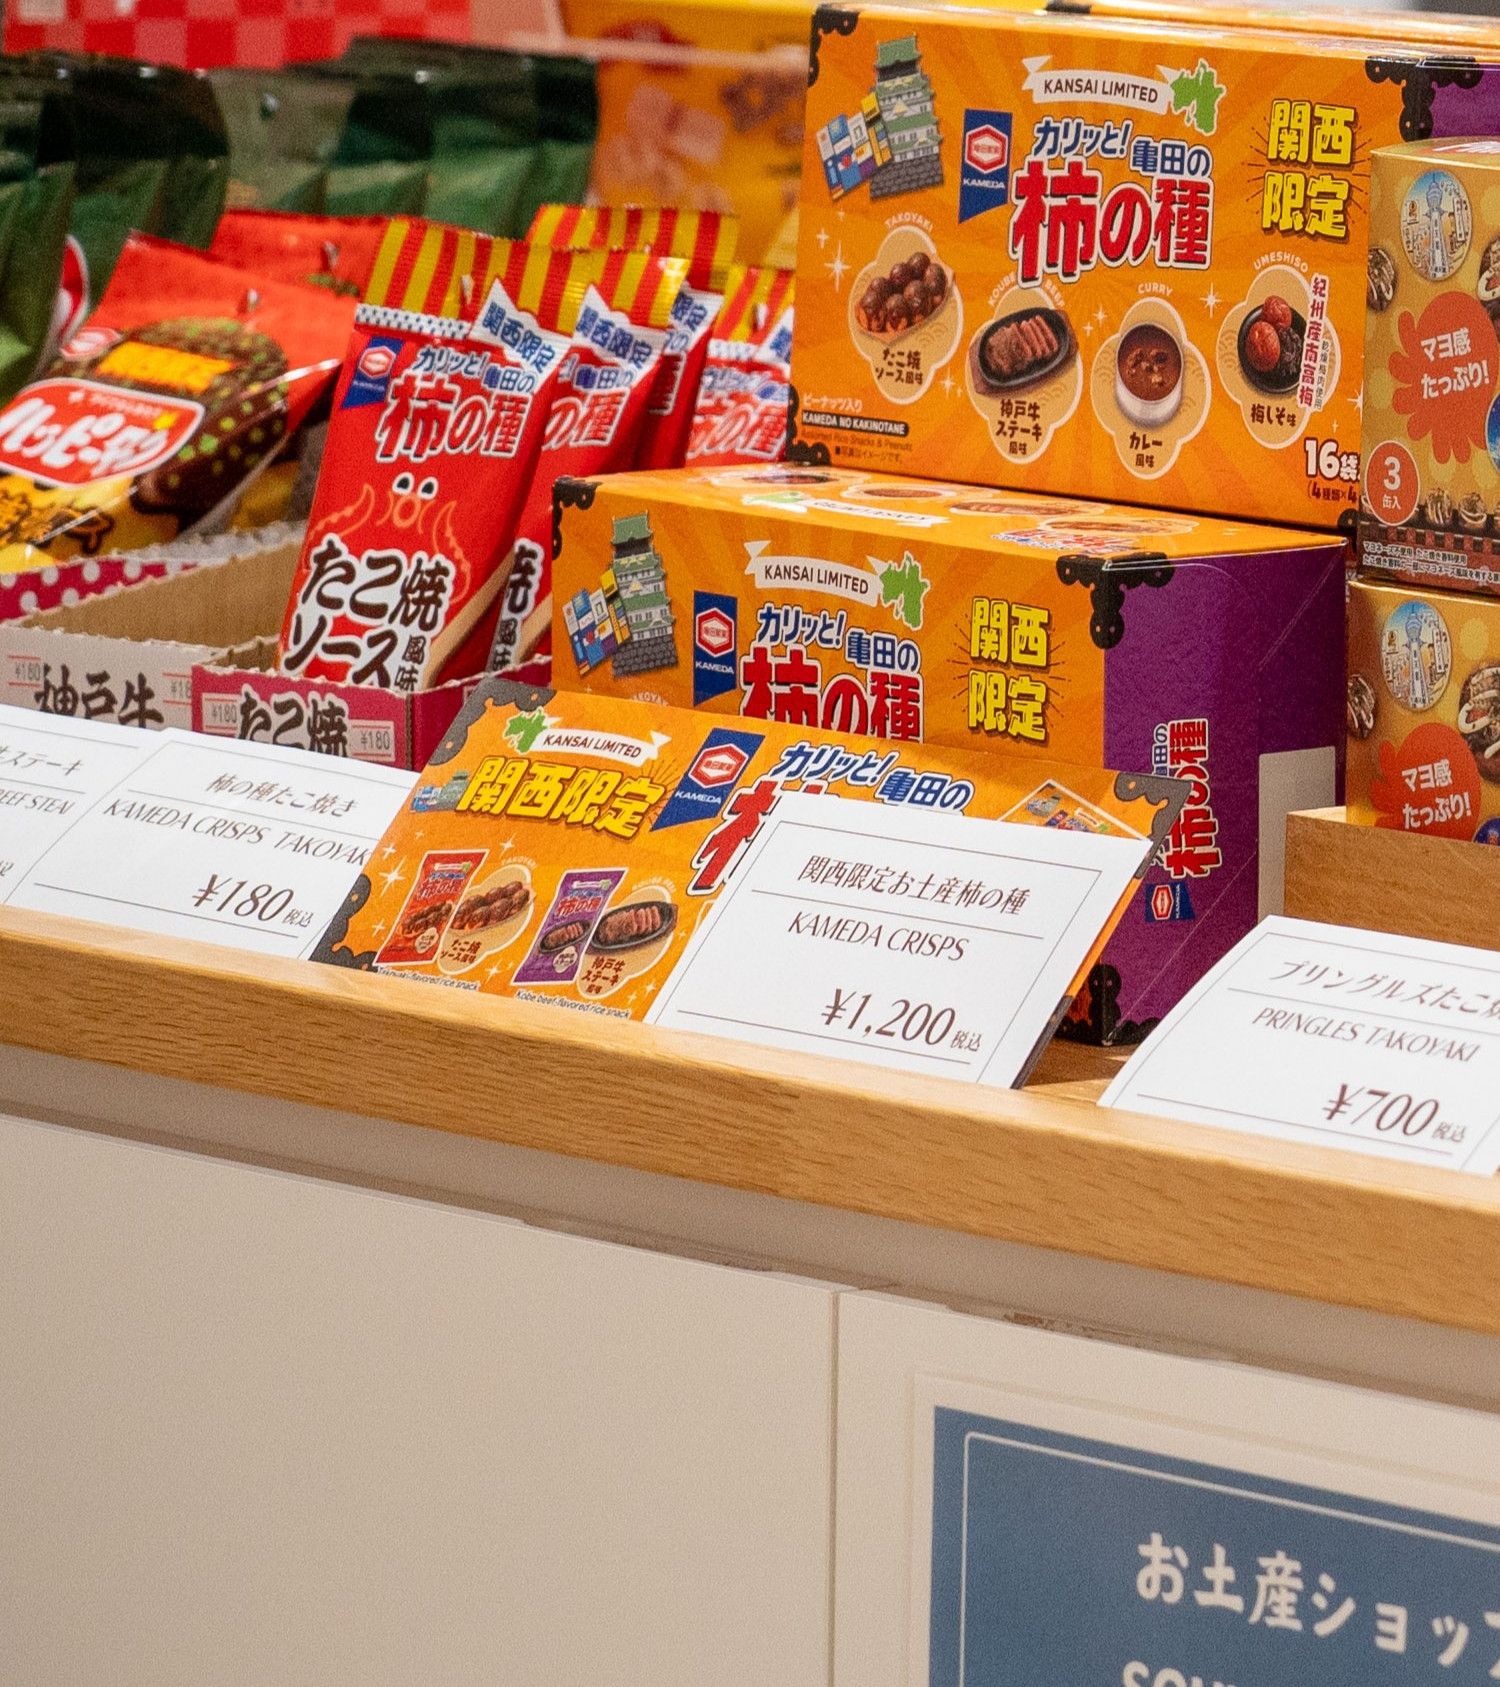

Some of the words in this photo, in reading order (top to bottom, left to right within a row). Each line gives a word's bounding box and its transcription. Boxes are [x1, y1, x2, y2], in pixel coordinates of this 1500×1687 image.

[1043, 79, 1098, 97] KANSAI
[1101, 81, 1158, 103] LIMITED
[1131, 139, 1211, 177] 亀田の
[1269, 100, 1357, 165] 関西
[1007, 161, 1212, 288] 柿の種
[1263, 173, 1352, 239] 限定
[483, 304, 556, 375] 関西限定
[1421, 327, 1471, 359] マヨ感
[376, 371, 533, 461] 柿の種
[802, 412, 837, 426] KAMEDA
[852, 417, 906, 435] KAKINOTANE
[1383, 457, 1402, 490] 3
[300, 540, 453, 628] たこ焼
[762, 563, 815, 588] KANSAI
[817, 570, 870, 596] LIMITED
[284, 615, 400, 687] ソース
[971, 598, 1051, 668] 関西
[15, 663, 41, 681] ¥180
[694, 661, 735, 675] KAMEDA
[968, 670, 1049, 744] 限定
[361, 730, 390, 751] ¥180
[542, 731, 594, 753] KANSAI
[594, 740, 643, 762] LIMITED
[206, 772, 359, 816] 柿の種たこ焼き
[456, 756, 669, 840] 関西限定
[674, 789, 722, 806] KAMEDA
[1402, 759, 1453, 789] マヨ感
[103, 799, 193, 831] KAMEDA
[193, 815, 265, 844] CRISPS
[274, 833, 373, 865] TAKOYAK
[193, 874, 295, 922] ¥180
[286, 909, 312, 927] 税込
[799, 854, 1029, 918] 関西限定お土産柿の種
[788, 912, 887, 953] KAMEDA
[884, 926, 969, 963] CRISPS
[516, 991, 536, 1003] Kobe
[587, 1003, 605, 1014] rice
[606, 1007, 630, 1019] snack
[821, 989, 957, 1048] ¥1,200
[952, 1029, 983, 1054] 税込
[1253, 1007, 1363, 1041] PRINGLES
[1367, 1027, 1481, 1062] TAKOYAKI
[1323, 1083, 1441, 1137] ¥700
[1433, 1122, 1465, 1143] 税込
